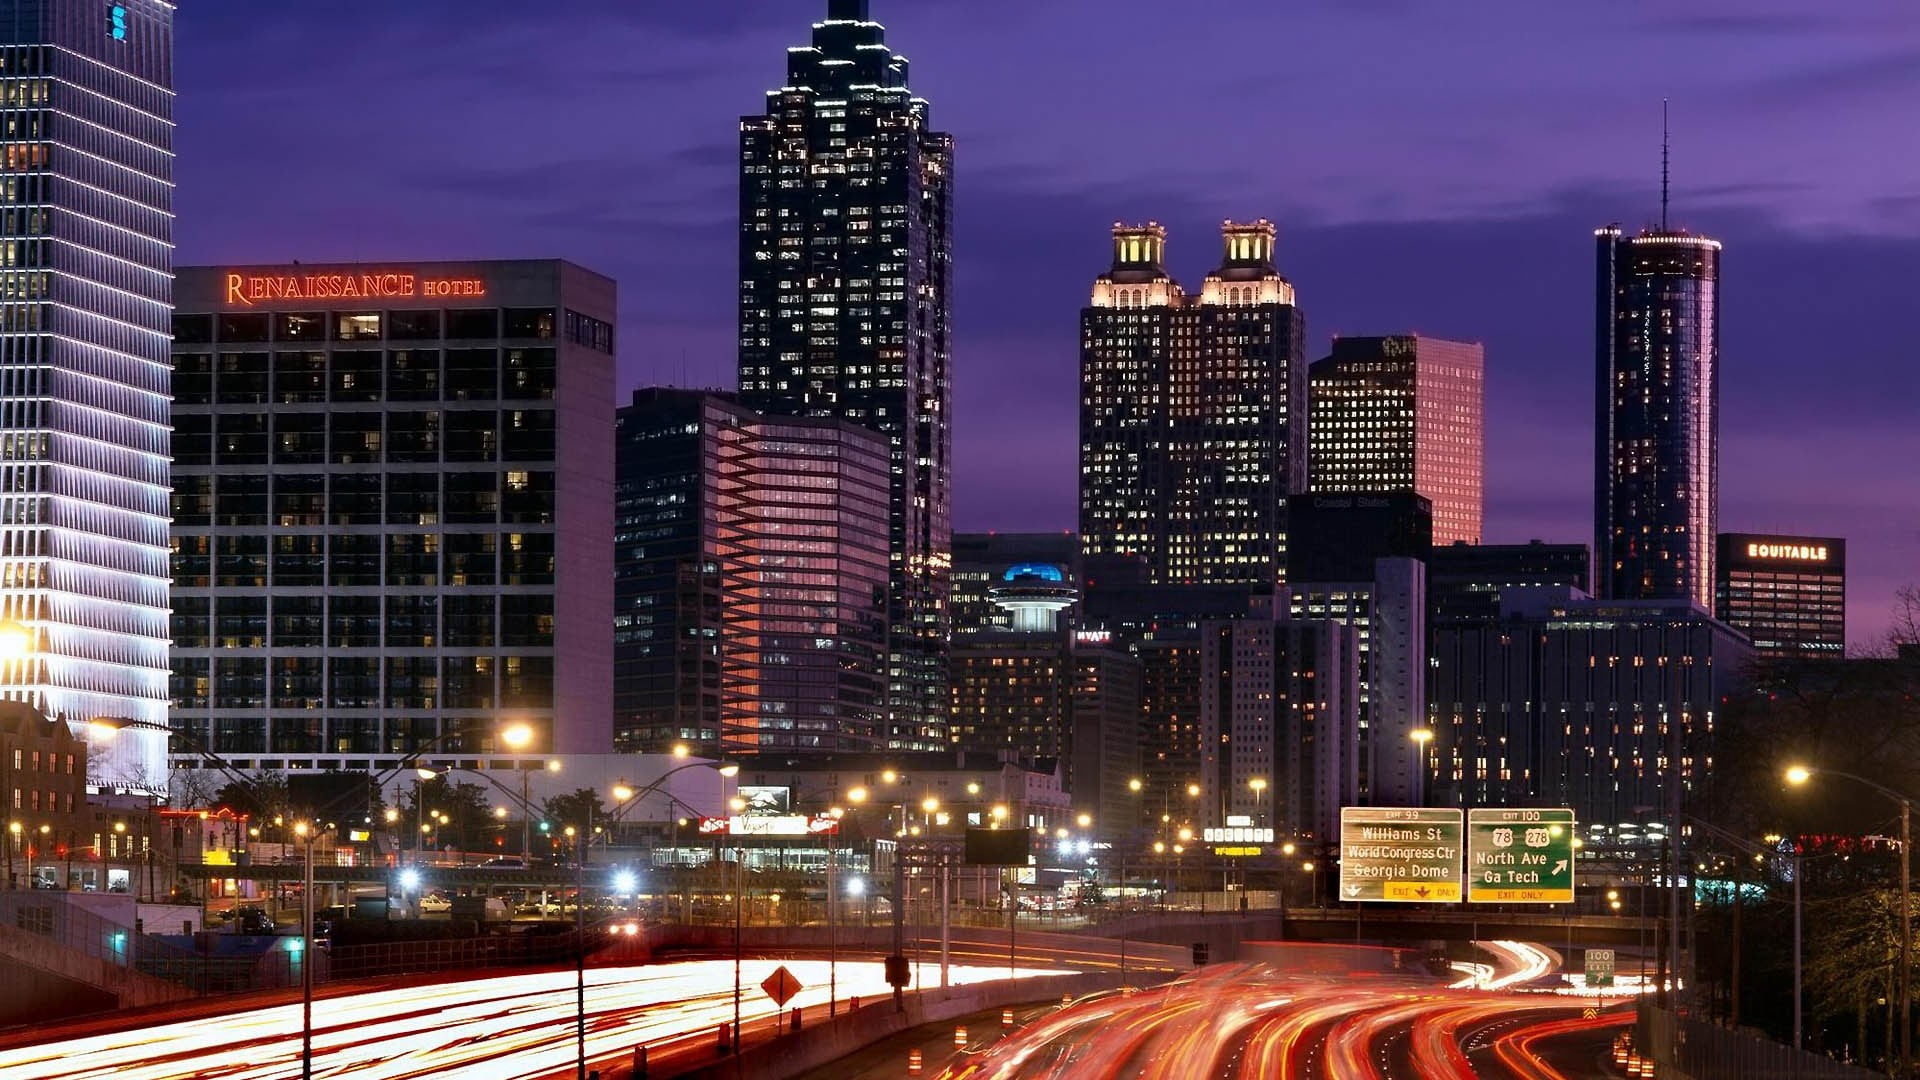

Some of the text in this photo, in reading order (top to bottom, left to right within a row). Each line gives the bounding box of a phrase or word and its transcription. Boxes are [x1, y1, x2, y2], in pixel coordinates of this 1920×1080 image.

[423, 280, 485, 296] HOTEL
[1748, 543, 1827, 560] EQUITABLE
[1077, 631, 1111, 642] HYATT
[1405, 811, 1419, 820] 99
[1522, 811, 1540, 820] 100
[1362, 827, 1442, 841] Williams St
[1495, 832, 1511, 843] 78
[1527, 832, 1547, 843] 278
[1348, 846, 1455, 862] World Congress Ctr
[1476, 852, 1547, 865] North Ave
[1353, 863, 1449, 880] Georgia Dome
[1484, 870, 1539, 883] Ga Tech
[1392, 888, 1456, 897] EXIT ONLY
[1498, 891, 1543, 899] EXIT ONLY
[1590, 951, 1610, 960] 100
